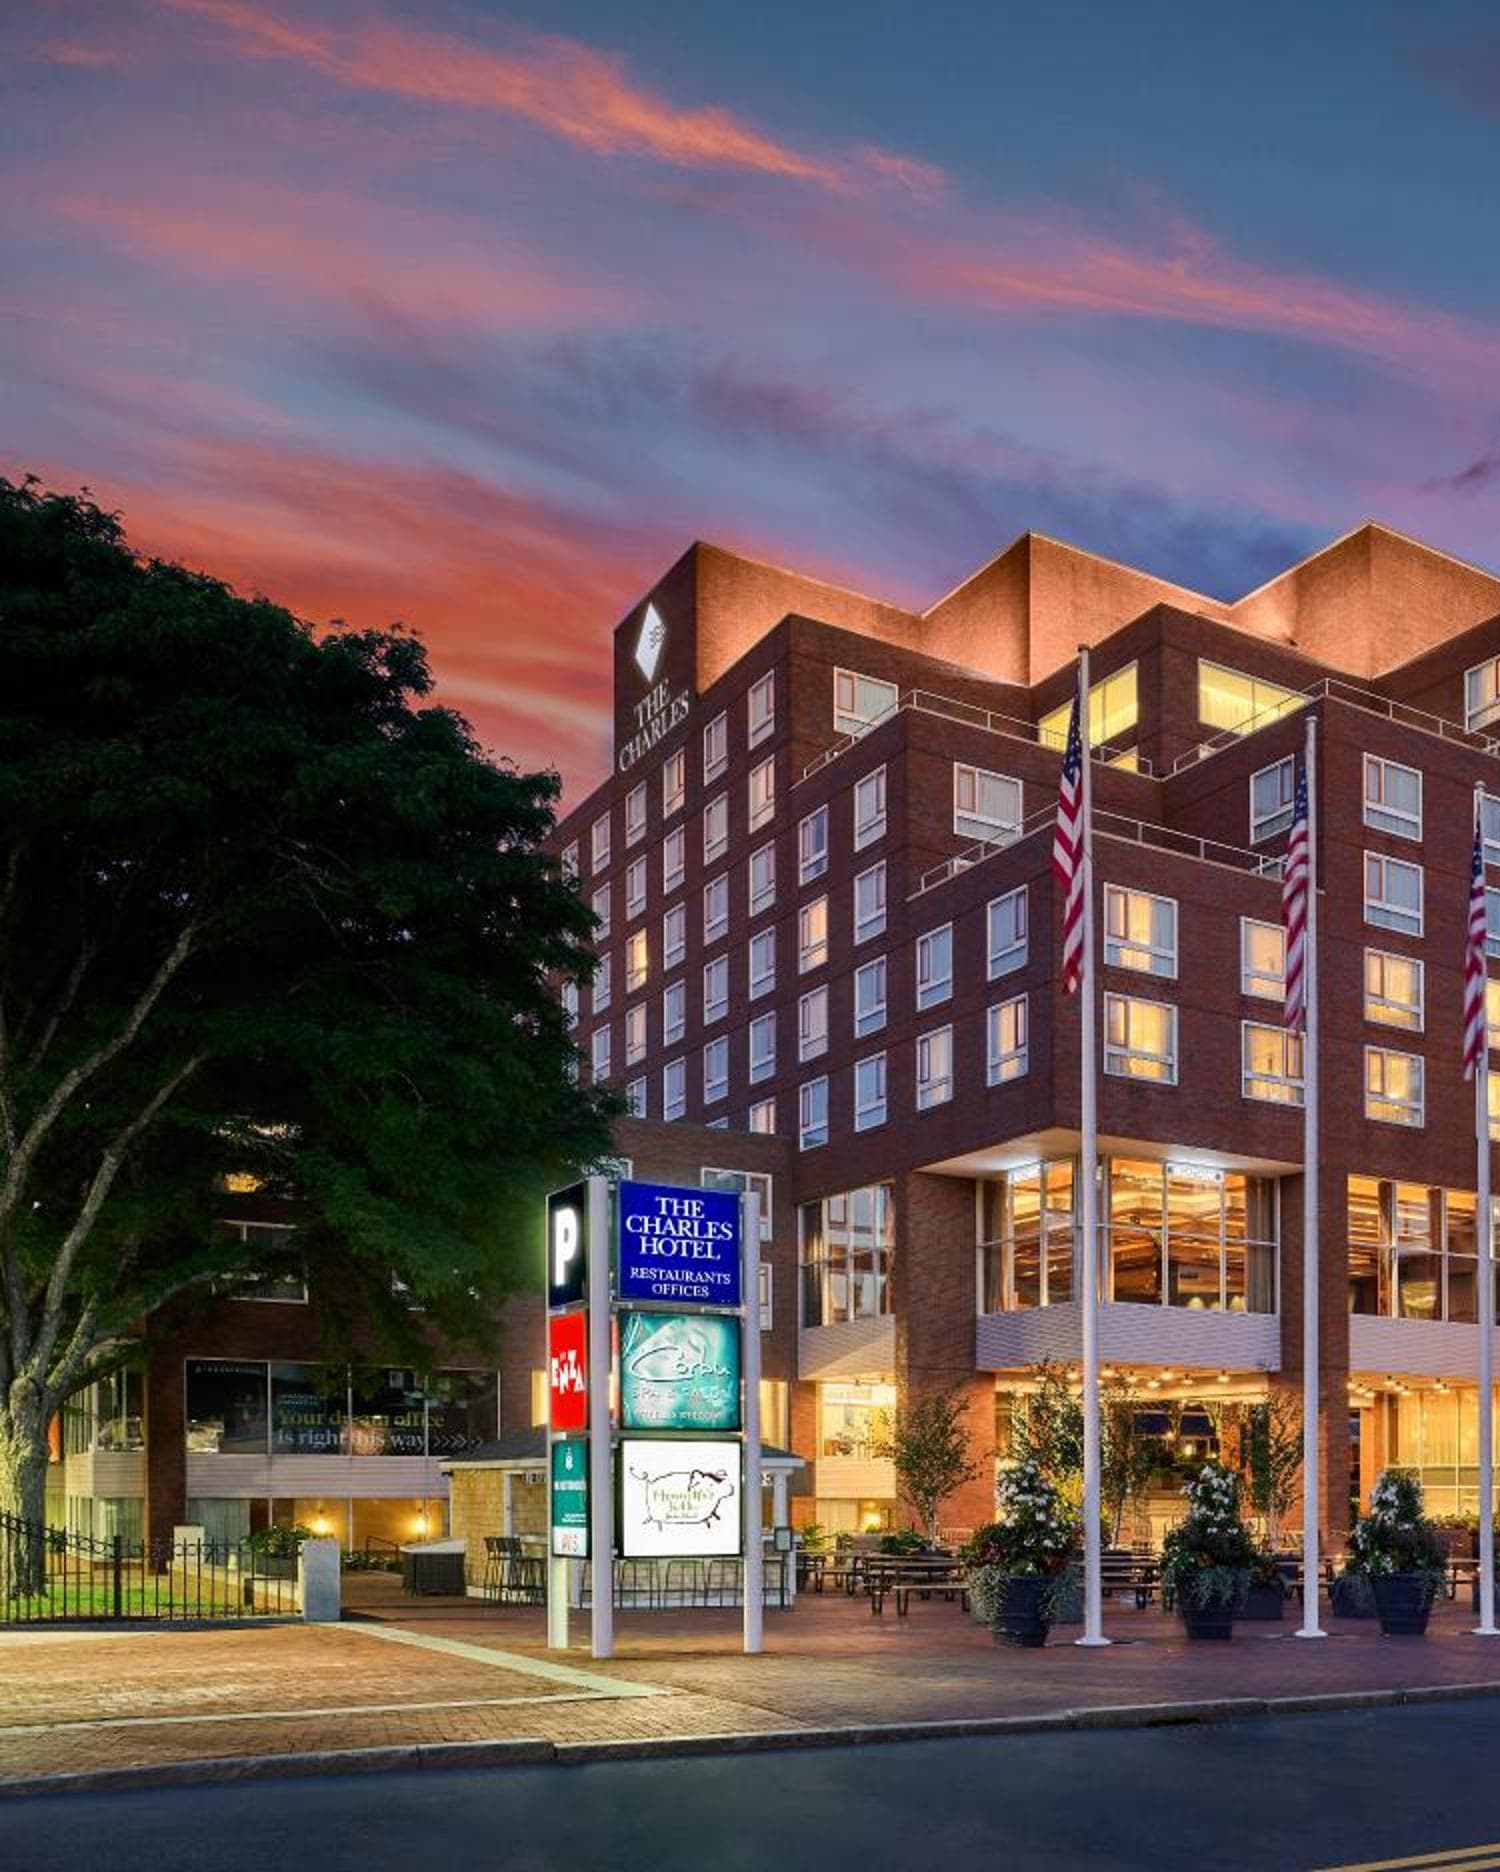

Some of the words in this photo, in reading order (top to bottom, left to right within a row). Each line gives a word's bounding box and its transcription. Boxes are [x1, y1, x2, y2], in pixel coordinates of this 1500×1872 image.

[633, 678, 670, 729] THE
[619, 690, 689, 771] CHARLES
[656, 1196, 705, 1219] THE
[626, 1215, 733, 1240] CHARLES
[554, 1207, 577, 1286] P
[640, 1236, 721, 1259] HOTEL
[630, 1266, 732, 1284] RESTAURANTS
[652, 1283, 710, 1297] OFFICES
